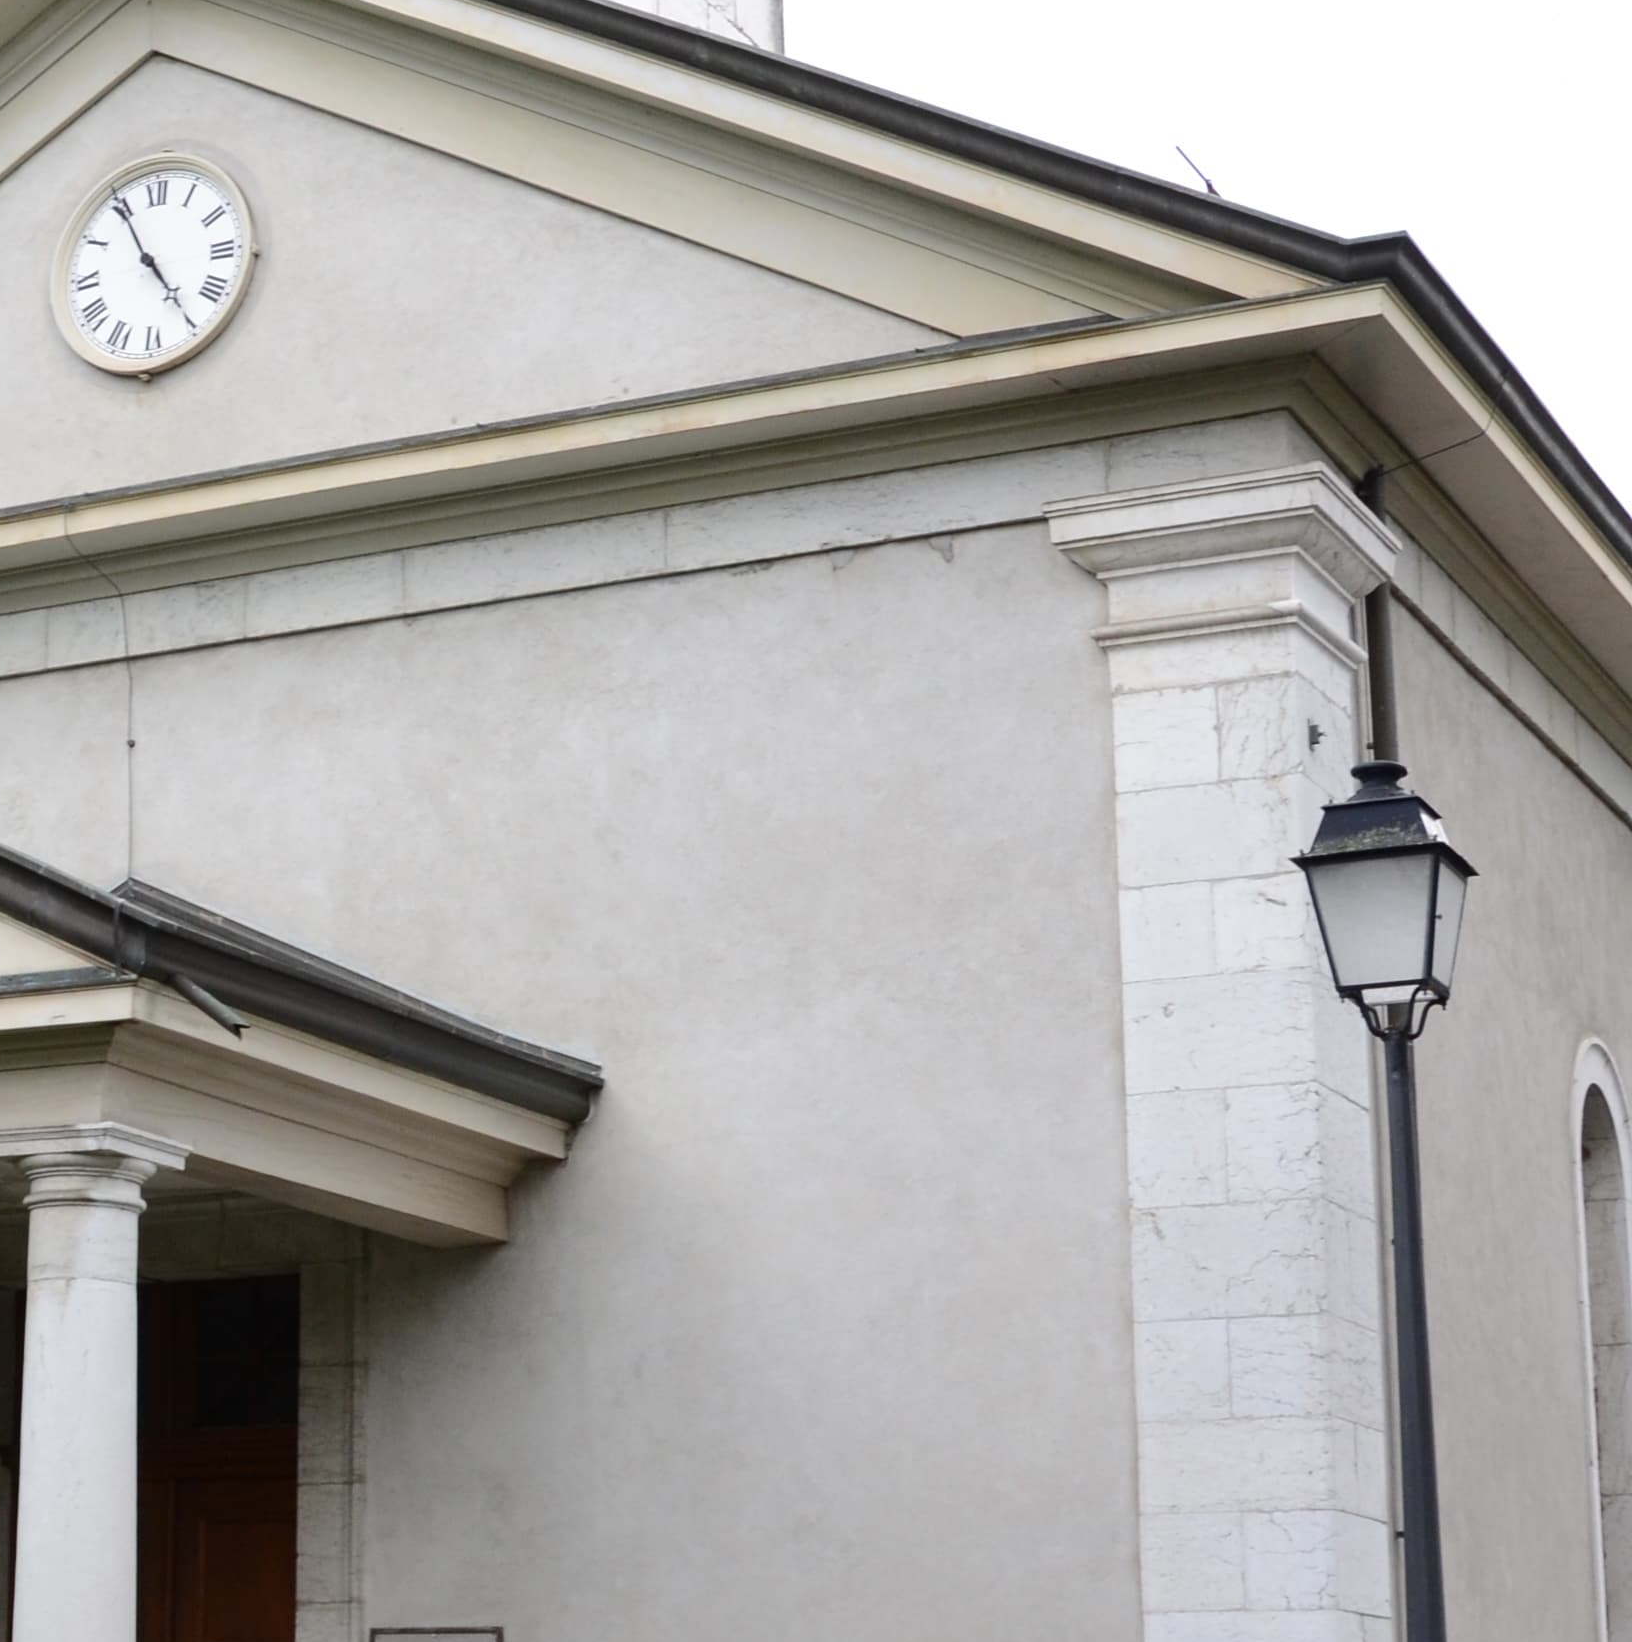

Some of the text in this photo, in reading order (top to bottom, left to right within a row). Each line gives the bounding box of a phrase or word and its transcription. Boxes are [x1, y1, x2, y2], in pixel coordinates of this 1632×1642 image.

[146, 180, 168, 208] XII
[182, 183, 197, 207] I
[201, 205, 226, 228] II
[210, 239, 235, 261] III
[198, 274, 228, 303] IIII
